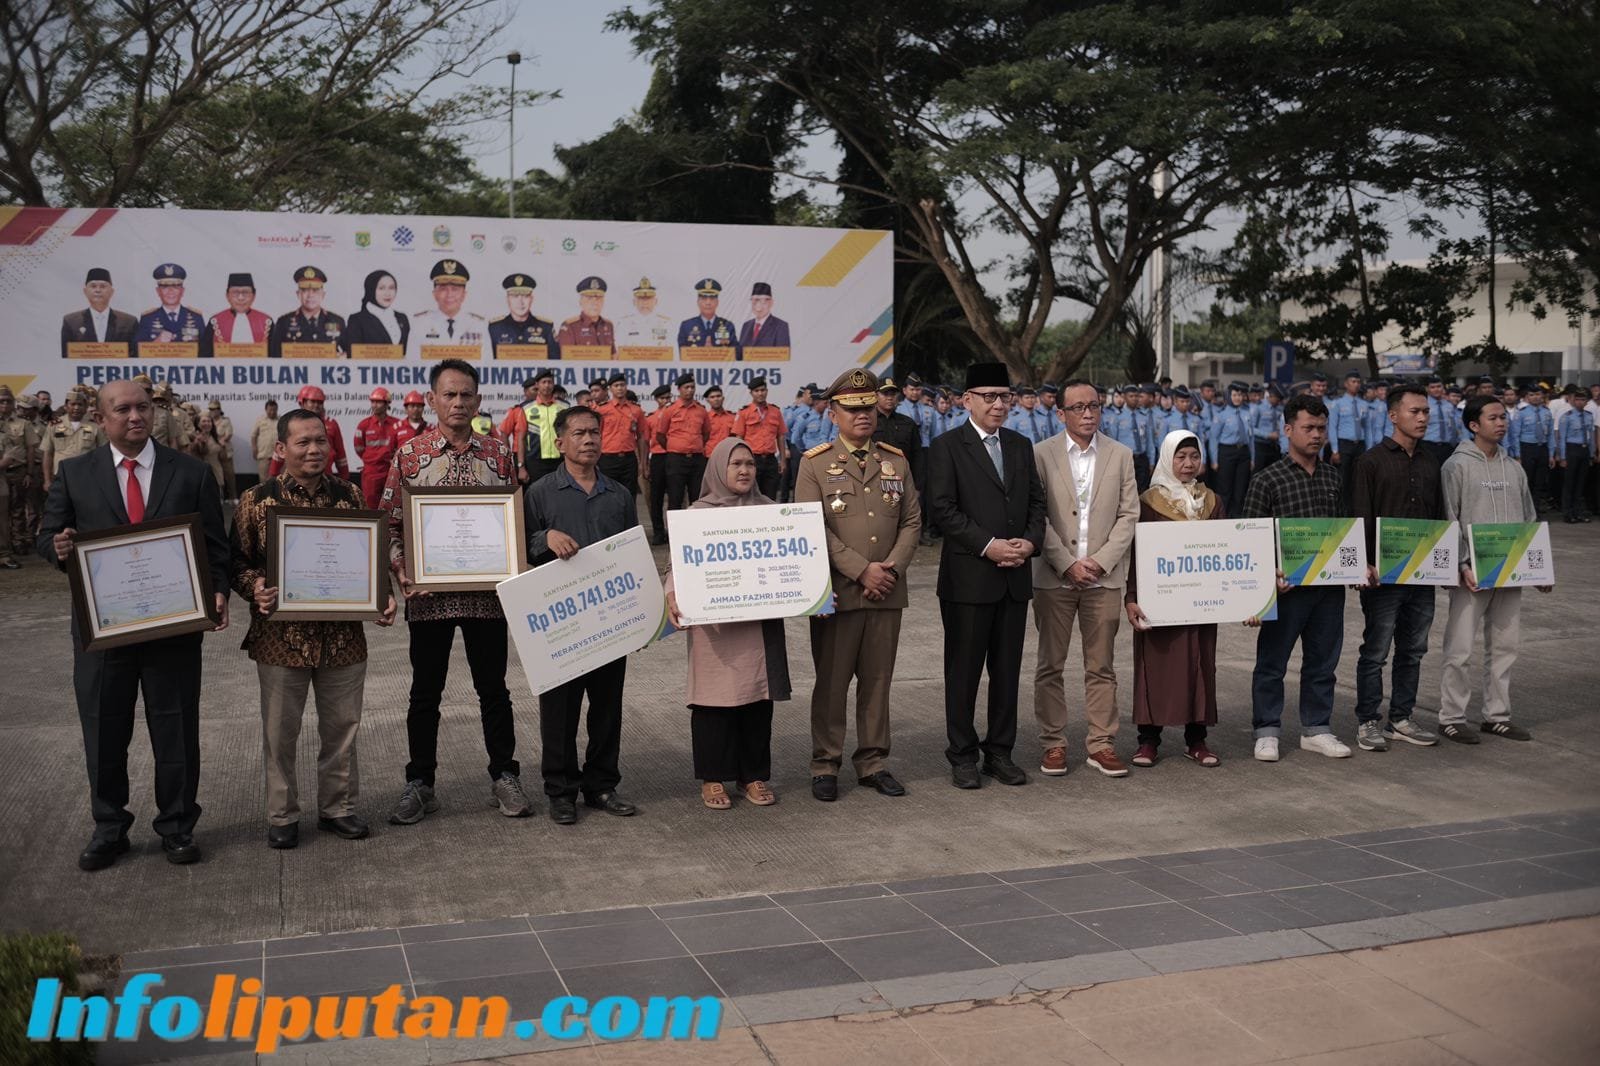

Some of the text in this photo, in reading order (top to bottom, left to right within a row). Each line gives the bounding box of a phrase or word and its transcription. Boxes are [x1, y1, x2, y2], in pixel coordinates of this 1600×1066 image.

[1271, 345, 1288, 380] P
[233, 366, 308, 385] BULAN
[321, 366, 351, 385] K3
[358, 366, 432, 385] TINGK
[476, 366, 577, 386] UMATRA
[728, 367, 782, 386] 2025
[204, 391, 246, 401] Kapasitas
[249, 391, 280, 401] Sumber
[702, 528, 739, 537] SANTUNAN
[756, 526, 770, 534] JHT,
[682, 537, 818, 567] Rp 203.532.540,-
[1157, 553, 1258, 577] Rp 70.166.667,-
[543, 579, 578, 597] SANTUNAN
[709, 590, 803, 605] AHMAD FAZHRI SIDDIK
[526, 611, 550, 634] Rp
[548, 571, 644, 625] 198.741.830,-
[1193, 599, 1225, 607] SUKINO
[551, 627, 614, 660] MERARYSTEVEN
[614, 612, 647, 632] GINTING
